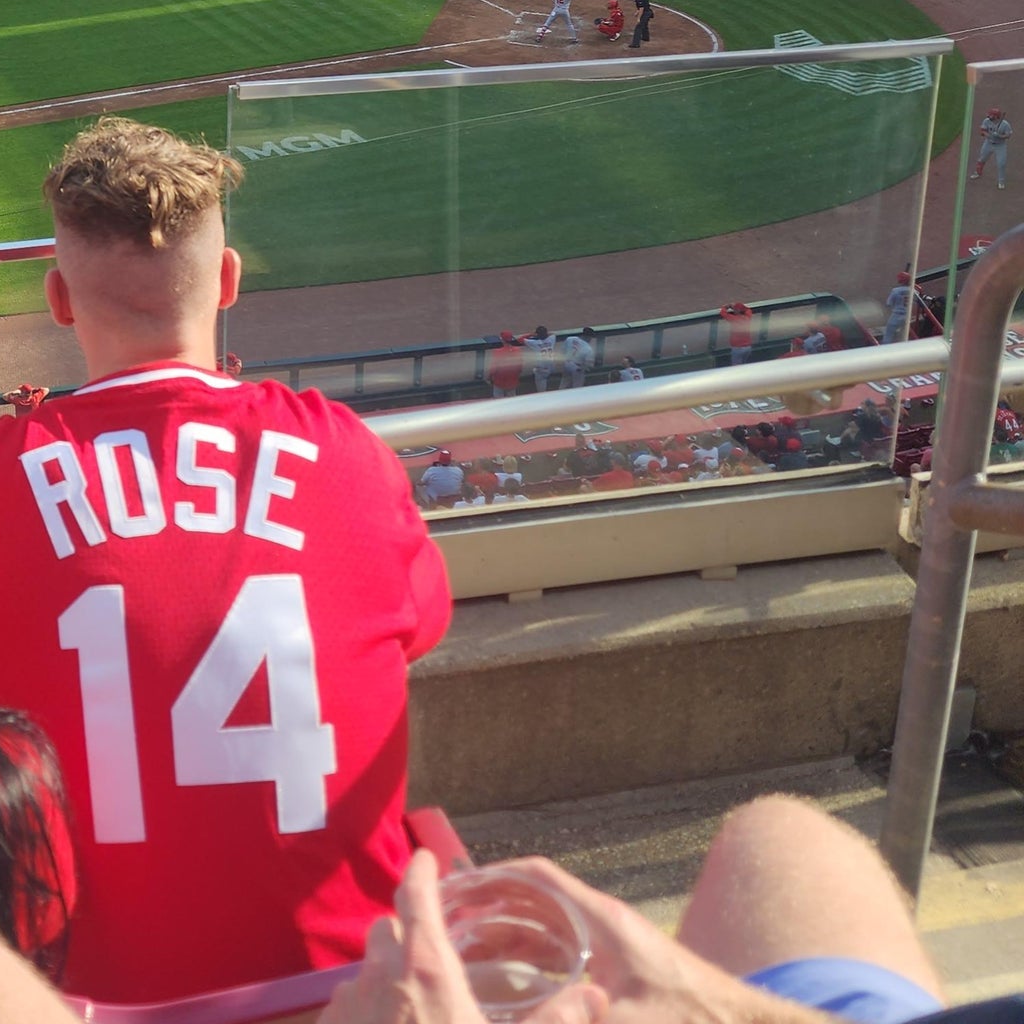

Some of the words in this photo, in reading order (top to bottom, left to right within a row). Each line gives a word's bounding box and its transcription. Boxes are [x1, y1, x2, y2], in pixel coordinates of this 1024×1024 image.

[236, 129, 368, 161] MGM
[1005, 418, 1019, 431] 44
[18, 421, 319, 559] ROSE
[57, 573, 338, 844] 14
